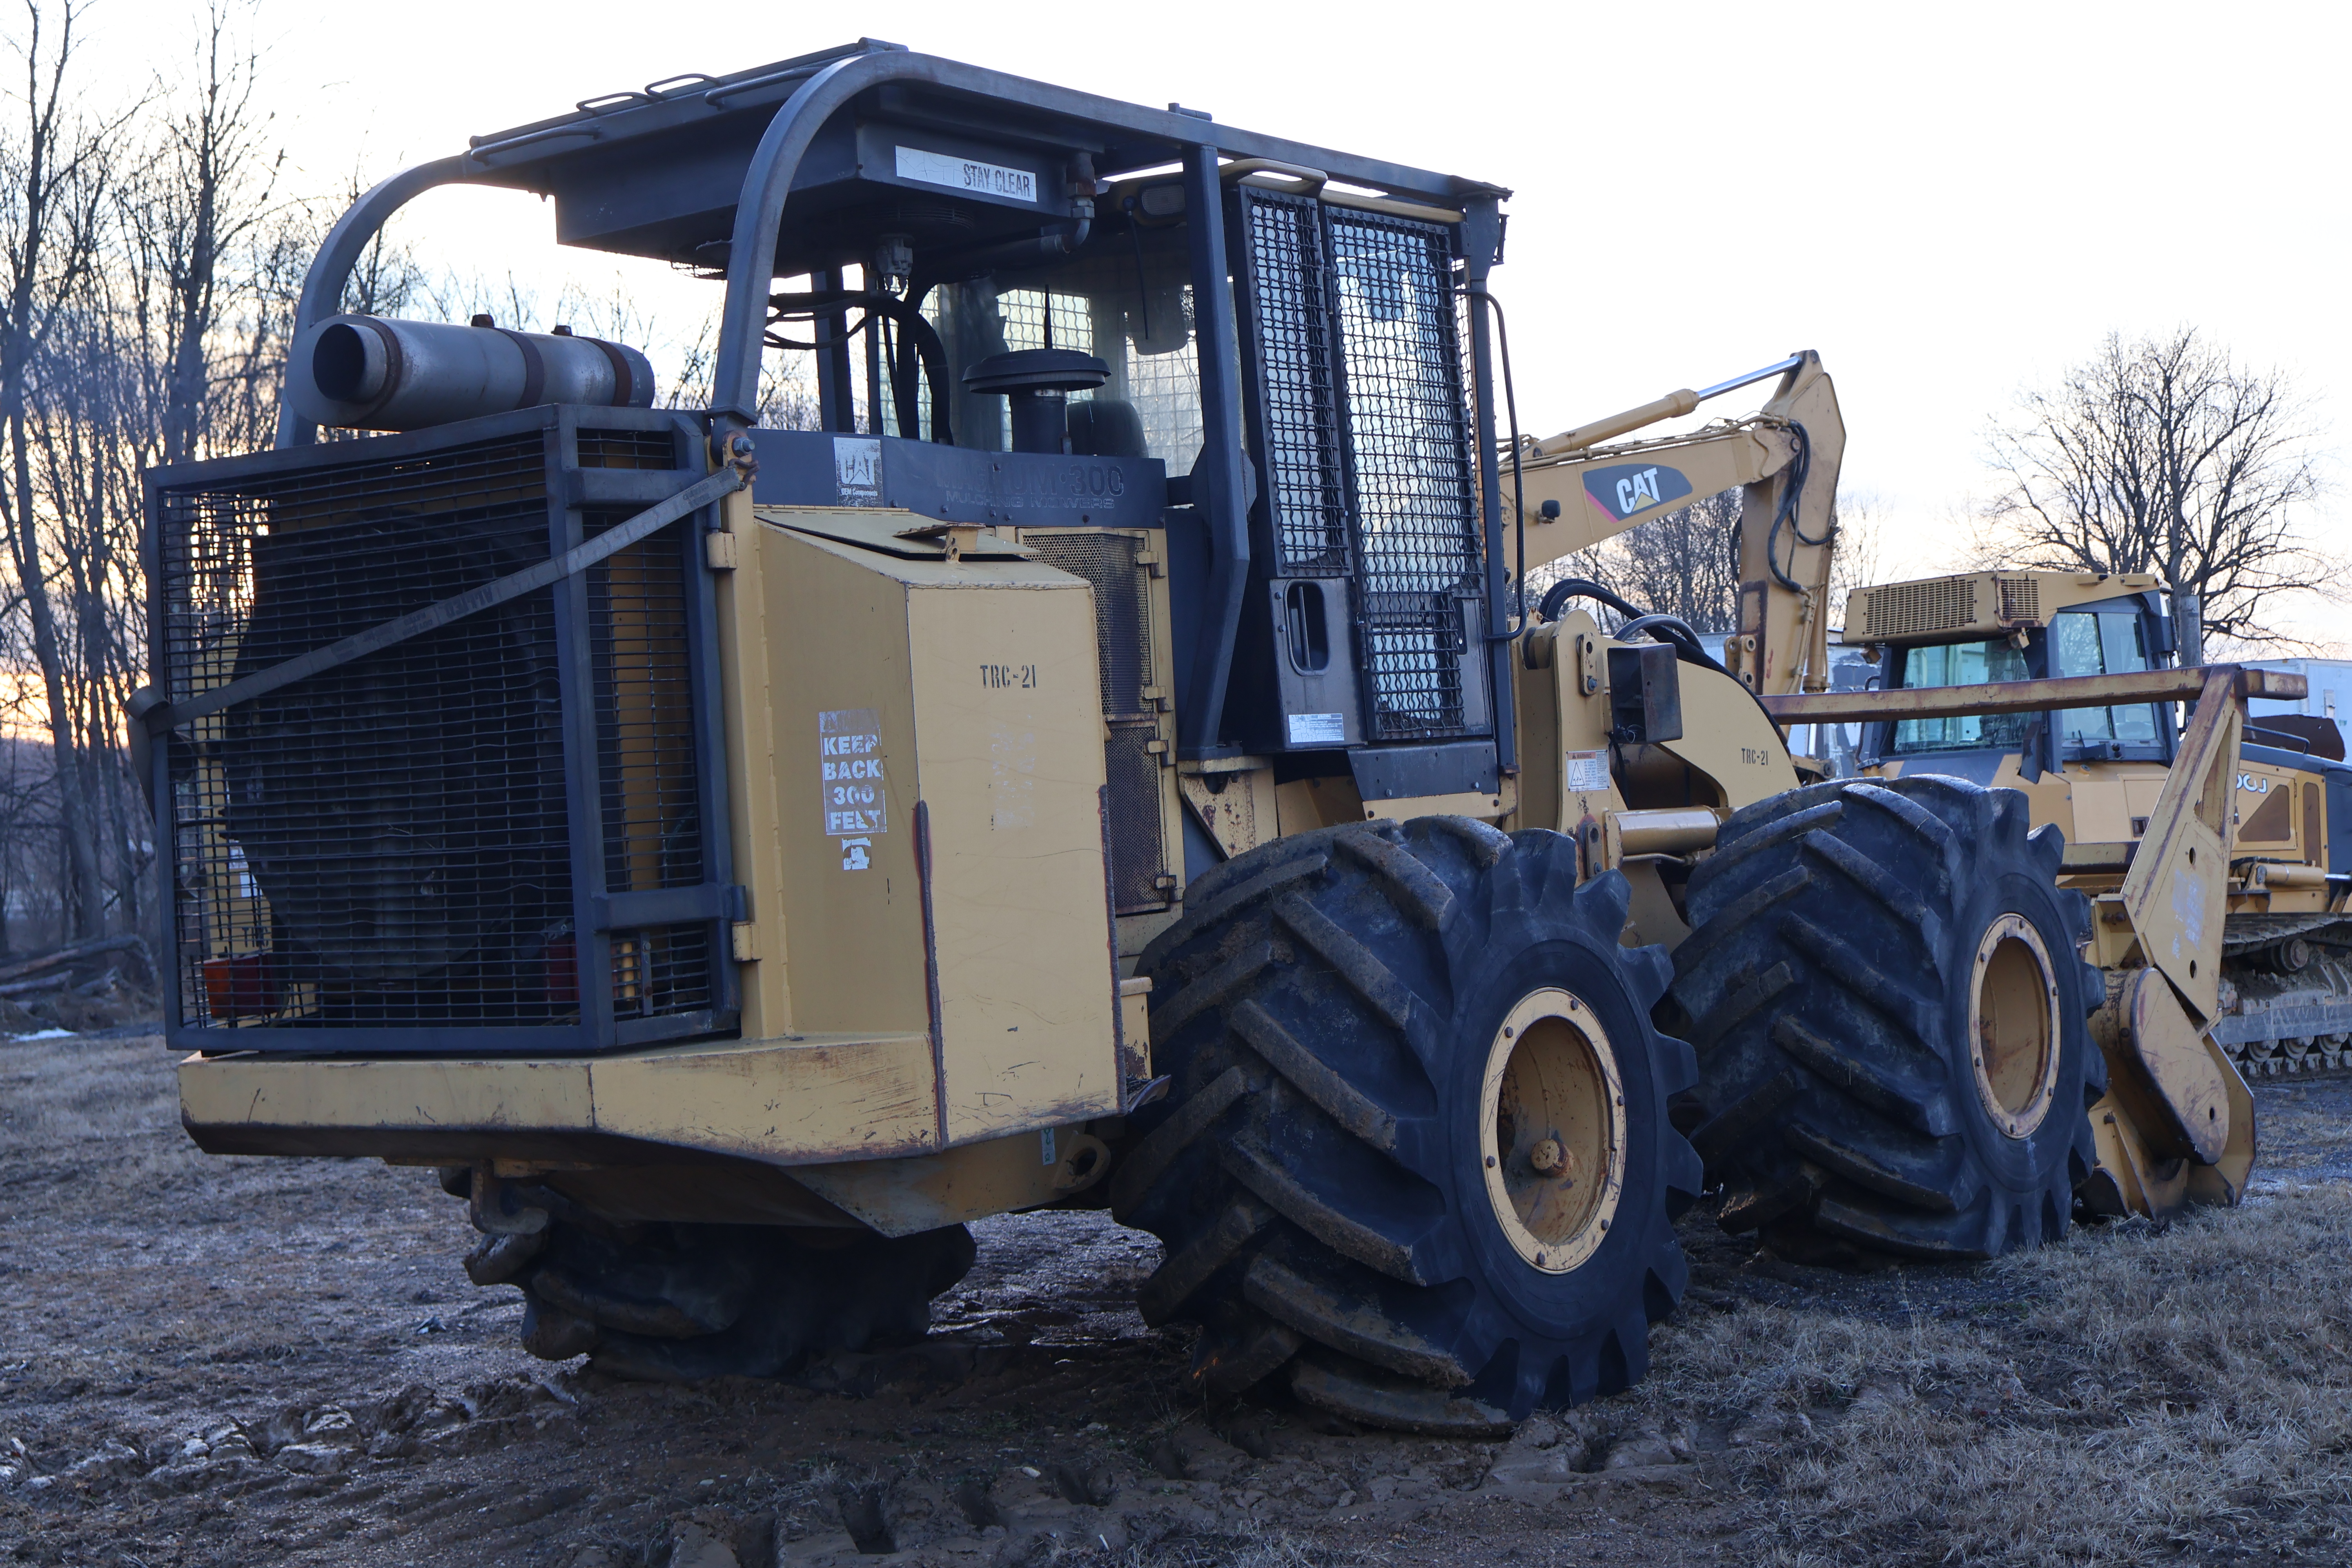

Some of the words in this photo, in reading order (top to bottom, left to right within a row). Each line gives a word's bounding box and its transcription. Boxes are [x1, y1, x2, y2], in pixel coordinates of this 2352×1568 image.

[963, 163, 990, 189] STAY
[995, 170, 1030, 198] CLEAR
[946, 490, 1024, 508] MULCHING
[1031, 497, 1114, 509] MOWERS
[1616, 467, 1661, 514] CAT
[980, 664, 1036, 688] TRC-21
[824, 734, 878, 755] KEEP
[1741, 748, 1768, 766] TRC-21
[824, 759, 881, 780] BACK
[833, 784, 875, 805] 300
